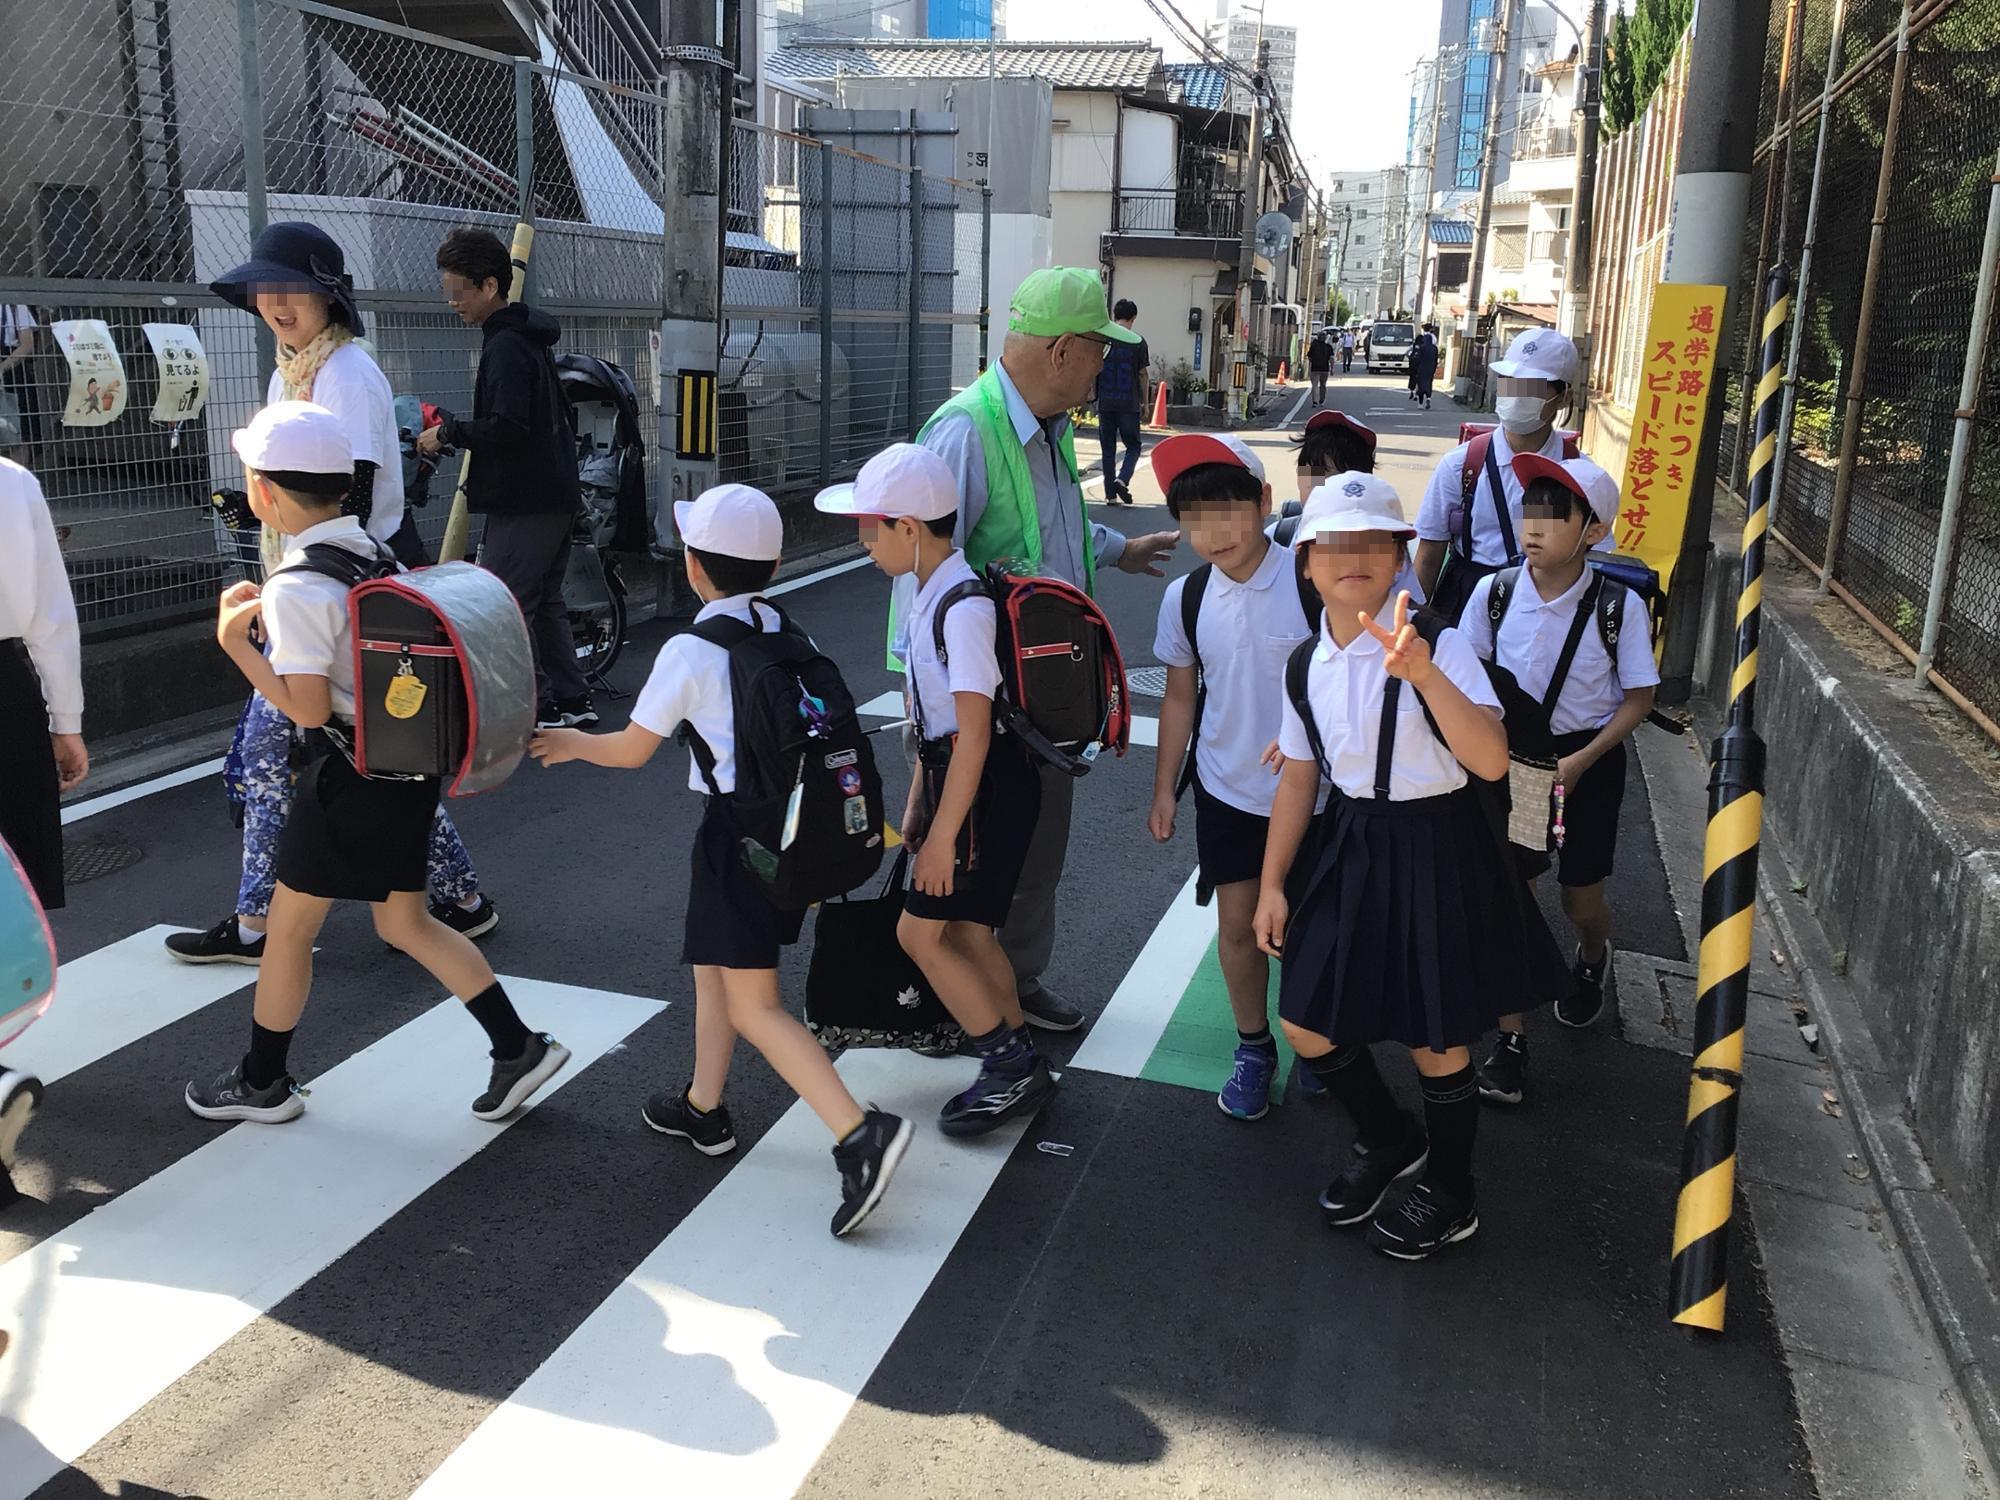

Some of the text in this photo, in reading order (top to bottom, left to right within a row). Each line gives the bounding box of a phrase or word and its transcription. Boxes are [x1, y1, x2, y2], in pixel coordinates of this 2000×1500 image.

[166, 363, 200, 376] 見てるよ
[1665, 305, 1715, 490] 通学路につき
